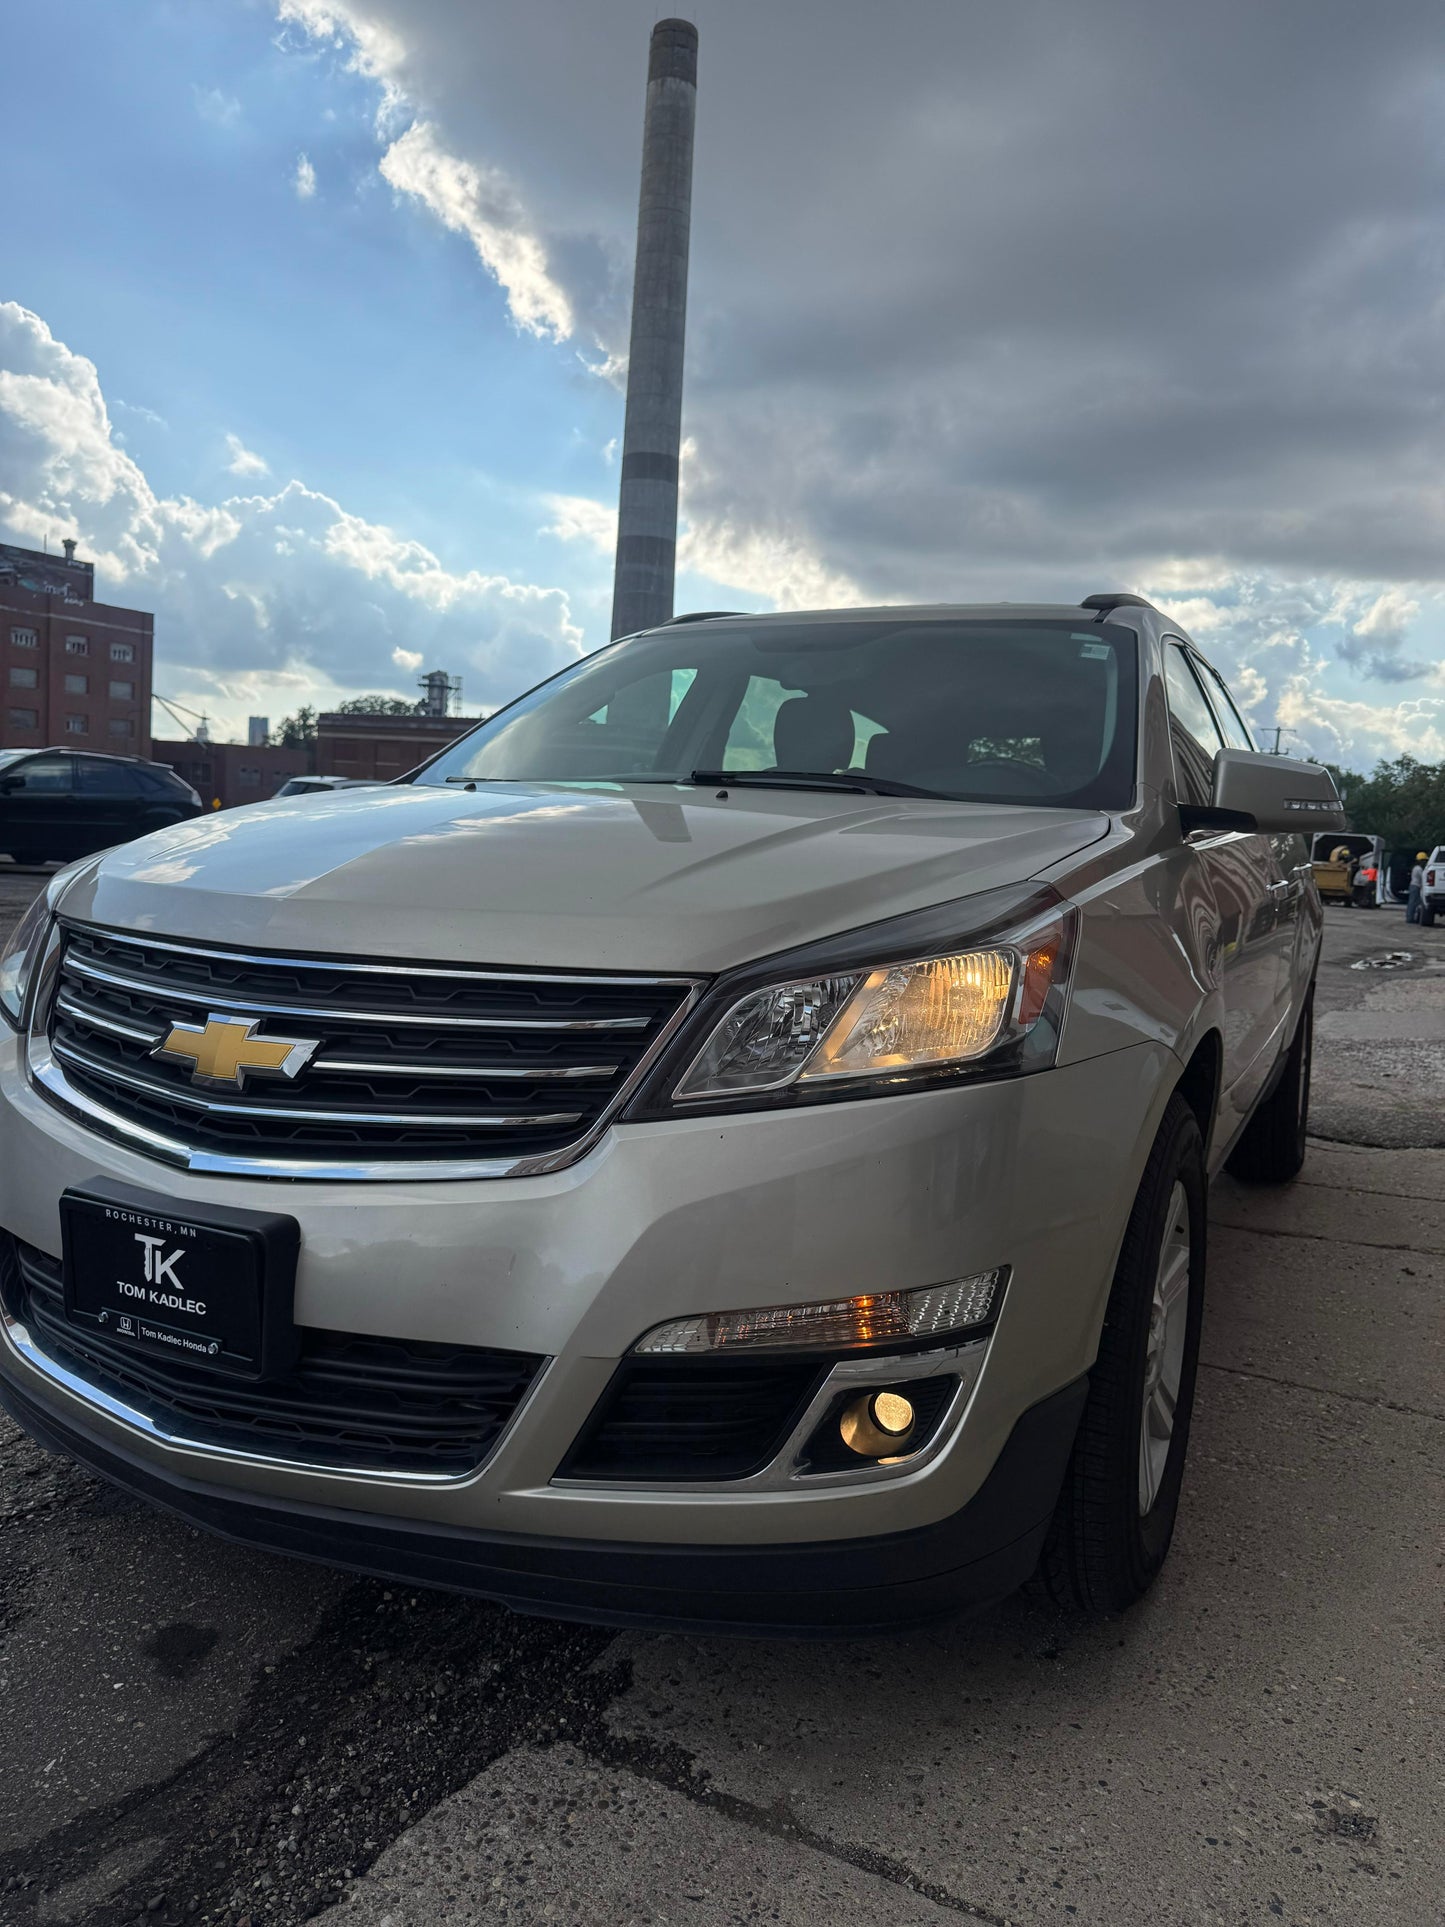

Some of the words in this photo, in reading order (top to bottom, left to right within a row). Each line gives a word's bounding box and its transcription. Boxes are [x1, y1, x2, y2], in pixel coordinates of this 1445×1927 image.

[180, 1226, 197, 1238] MN
[116, 1280, 146, 1300] TOM
[149, 1290, 207, 1315] KADLEC
[141, 1326, 157, 1339] Tom
[157, 1331, 182, 1346] Kadlec
[183, 1339, 207, 1353] Honda
